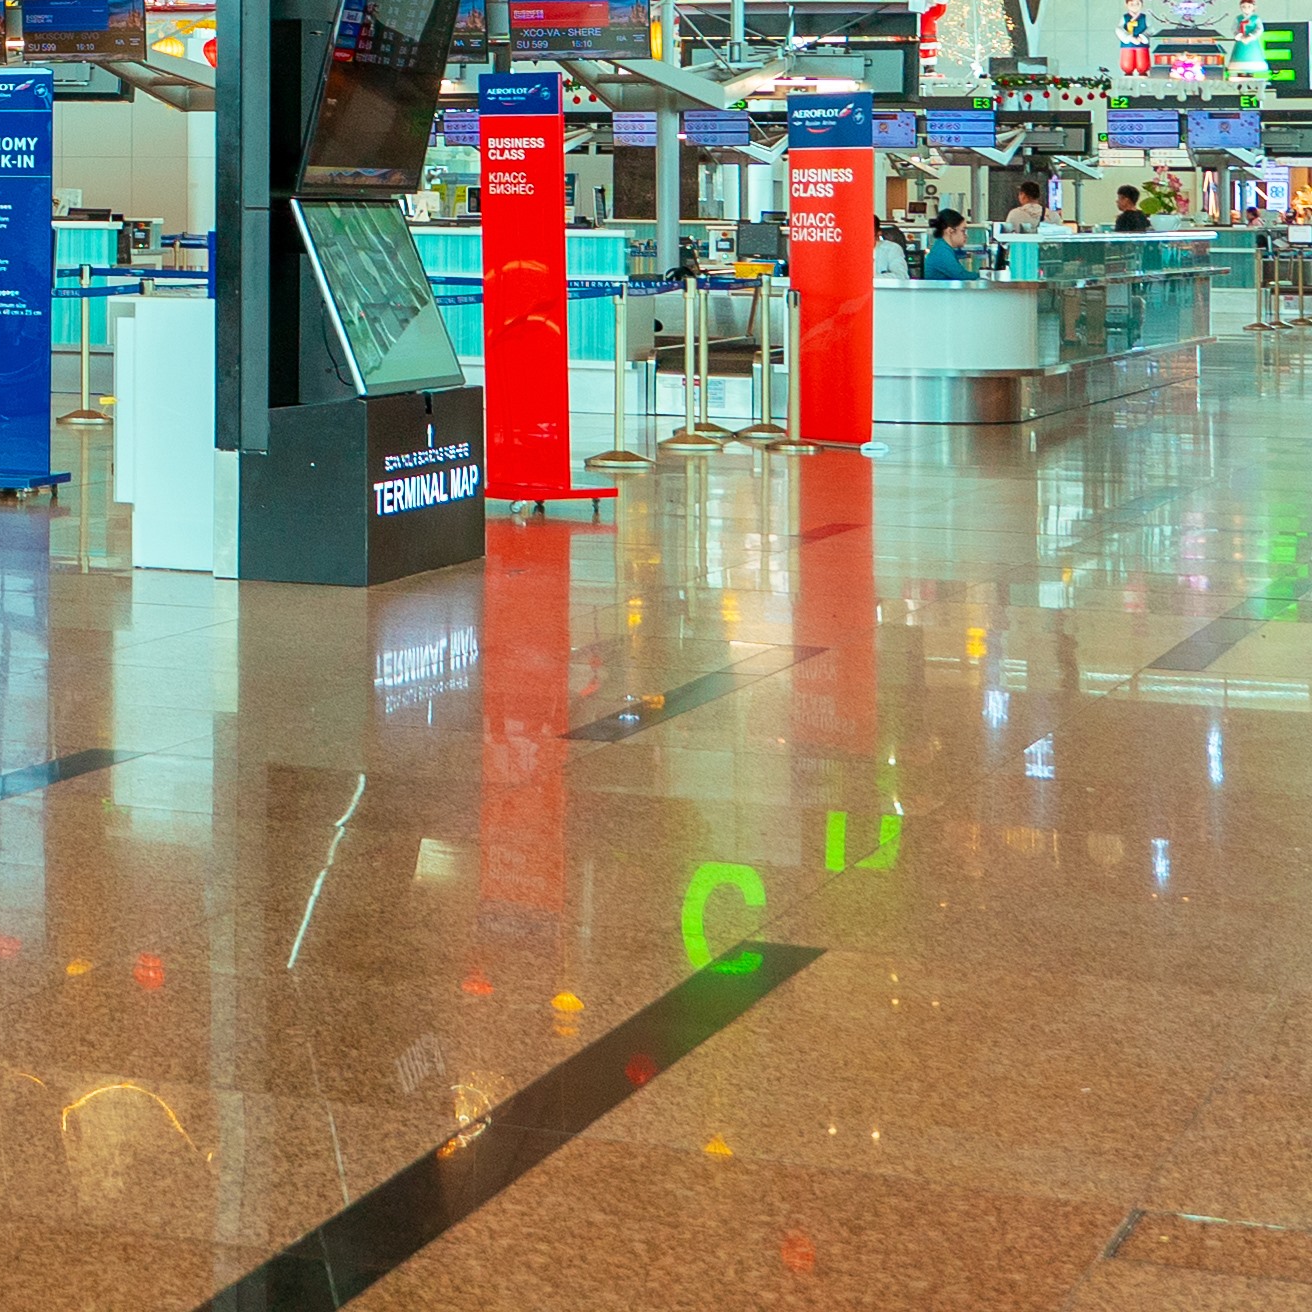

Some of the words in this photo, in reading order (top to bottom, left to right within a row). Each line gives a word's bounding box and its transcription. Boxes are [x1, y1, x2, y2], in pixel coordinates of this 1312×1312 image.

[520, 29, 561, 37] -XCO-VA
[567, 28, 602, 37] SHERE
[28, 44, 40, 52] SU
[41, 43, 56, 52] 599
[76, 43, 95, 51] 16:10
[516, 40, 530, 49] SU
[531, 40, 548, 49] 599
[571, 39, 592, 48] 16:10
[973, 97, 990, 109] E3
[1110, 97, 1129, 108] E2
[1240, 96, 1258, 107] E1
[792, 108, 839, 118] AEROFLOT
[488, 138, 545, 149] BUSINESS
[488, 150, 525, 160] CLASS
[489, 172, 527, 183] КЛАСС
[792, 168, 853, 182] BUSINESS
[489, 184, 535, 195] БИЗНЕС
[792, 184, 834, 197] CLASS
[792, 213, 835, 227] КЛАСС
[792, 228, 842, 242] БИЗНЕС
[373, 471, 449, 516] TERMINAL
[450, 464, 479, 499] MAP
